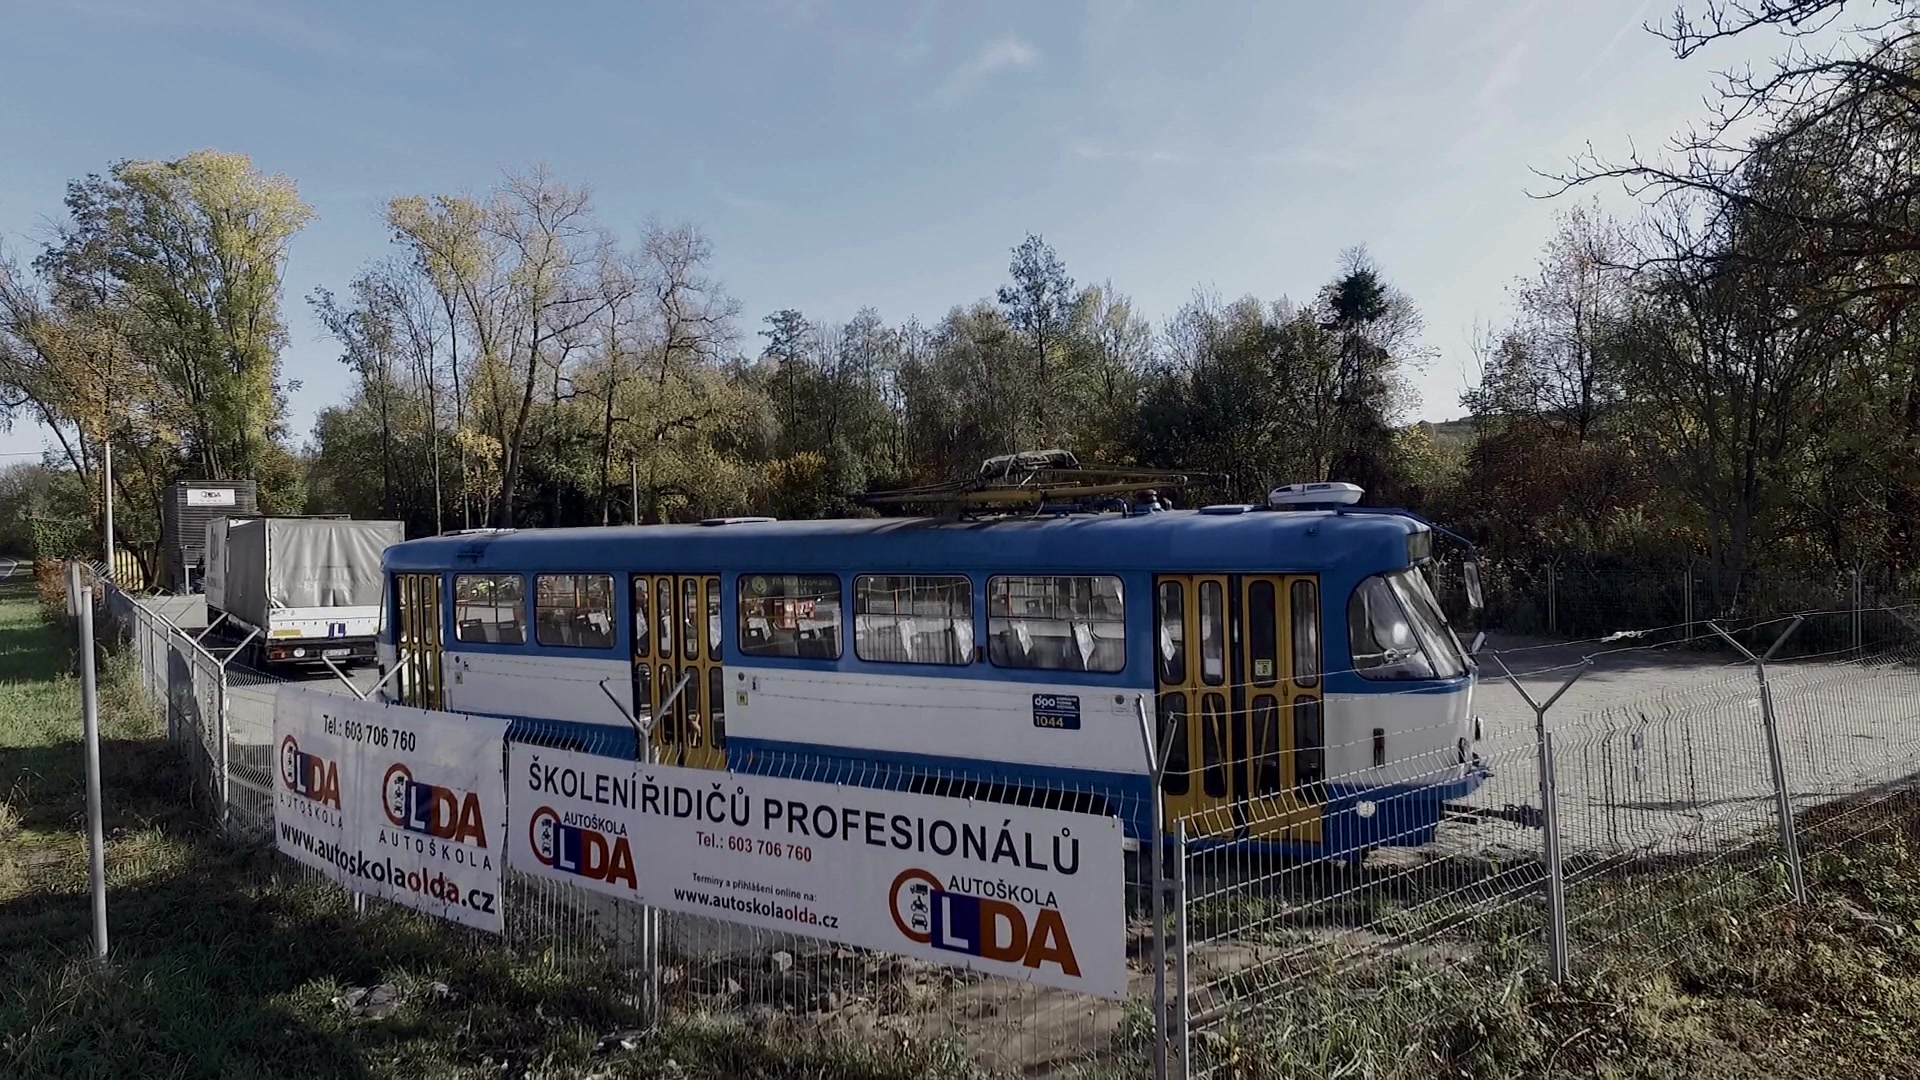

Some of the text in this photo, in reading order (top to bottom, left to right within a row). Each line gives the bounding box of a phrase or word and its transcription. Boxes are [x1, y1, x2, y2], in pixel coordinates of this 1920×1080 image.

[323, 714, 416, 752] Tel.: 603 706 760
[1035, 715, 1064, 728] 1044
[281, 734, 341, 810] OLDA
[279, 794, 344, 830] AUTOŠKOLA
[382, 762, 487, 849] OLDA
[528, 754, 1080, 876] ŠKOLENÍ ŘIDIČŮ PROFESIONÁLŮ
[563, 810, 628, 837] AUTOŠKOLA
[379, 829, 492, 871] AUTOŠKOLA
[529, 805, 638, 891] OLDA
[696, 831, 813, 863] Tel.: 603 706 760
[280, 821, 496, 916] www.autoskolaolda.cz
[674, 887, 839, 929] www.autoskolaolda.cz
[775, 886, 802, 899] online
[803, 892, 817, 902] na:
[947, 874, 1059, 909] AUTOŠKOLA
[888, 867, 1082, 979] OLDA
